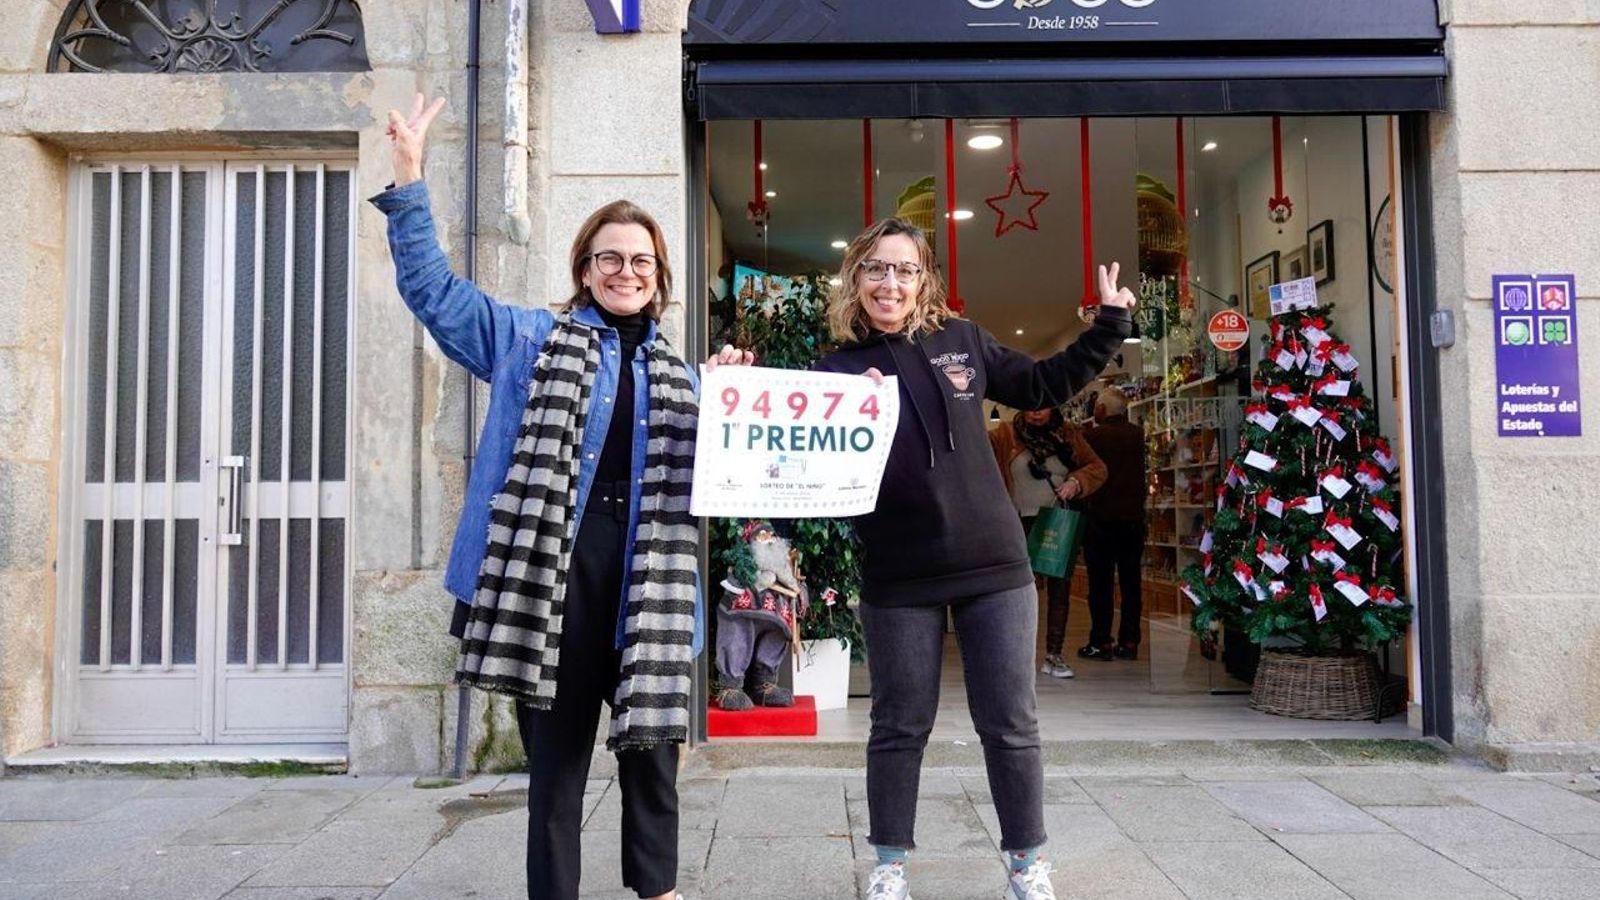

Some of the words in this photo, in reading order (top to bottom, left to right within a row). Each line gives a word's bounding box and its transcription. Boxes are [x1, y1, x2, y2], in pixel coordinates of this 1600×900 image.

[1028, 16, 1066, 29] Desde
[1069, 16, 1099, 29] 1958
[1217, 314, 1239, 328] +18
[1501, 383, 1550, 396] Loterías
[1551, 386, 1560, 397] y
[721, 387, 880, 421] 94974
[1502, 401, 1556, 415] Apuestas
[1558, 400, 1578, 413] del
[1502, 418, 1543, 431] Estado
[747, 424, 875, 453] PREMIO
